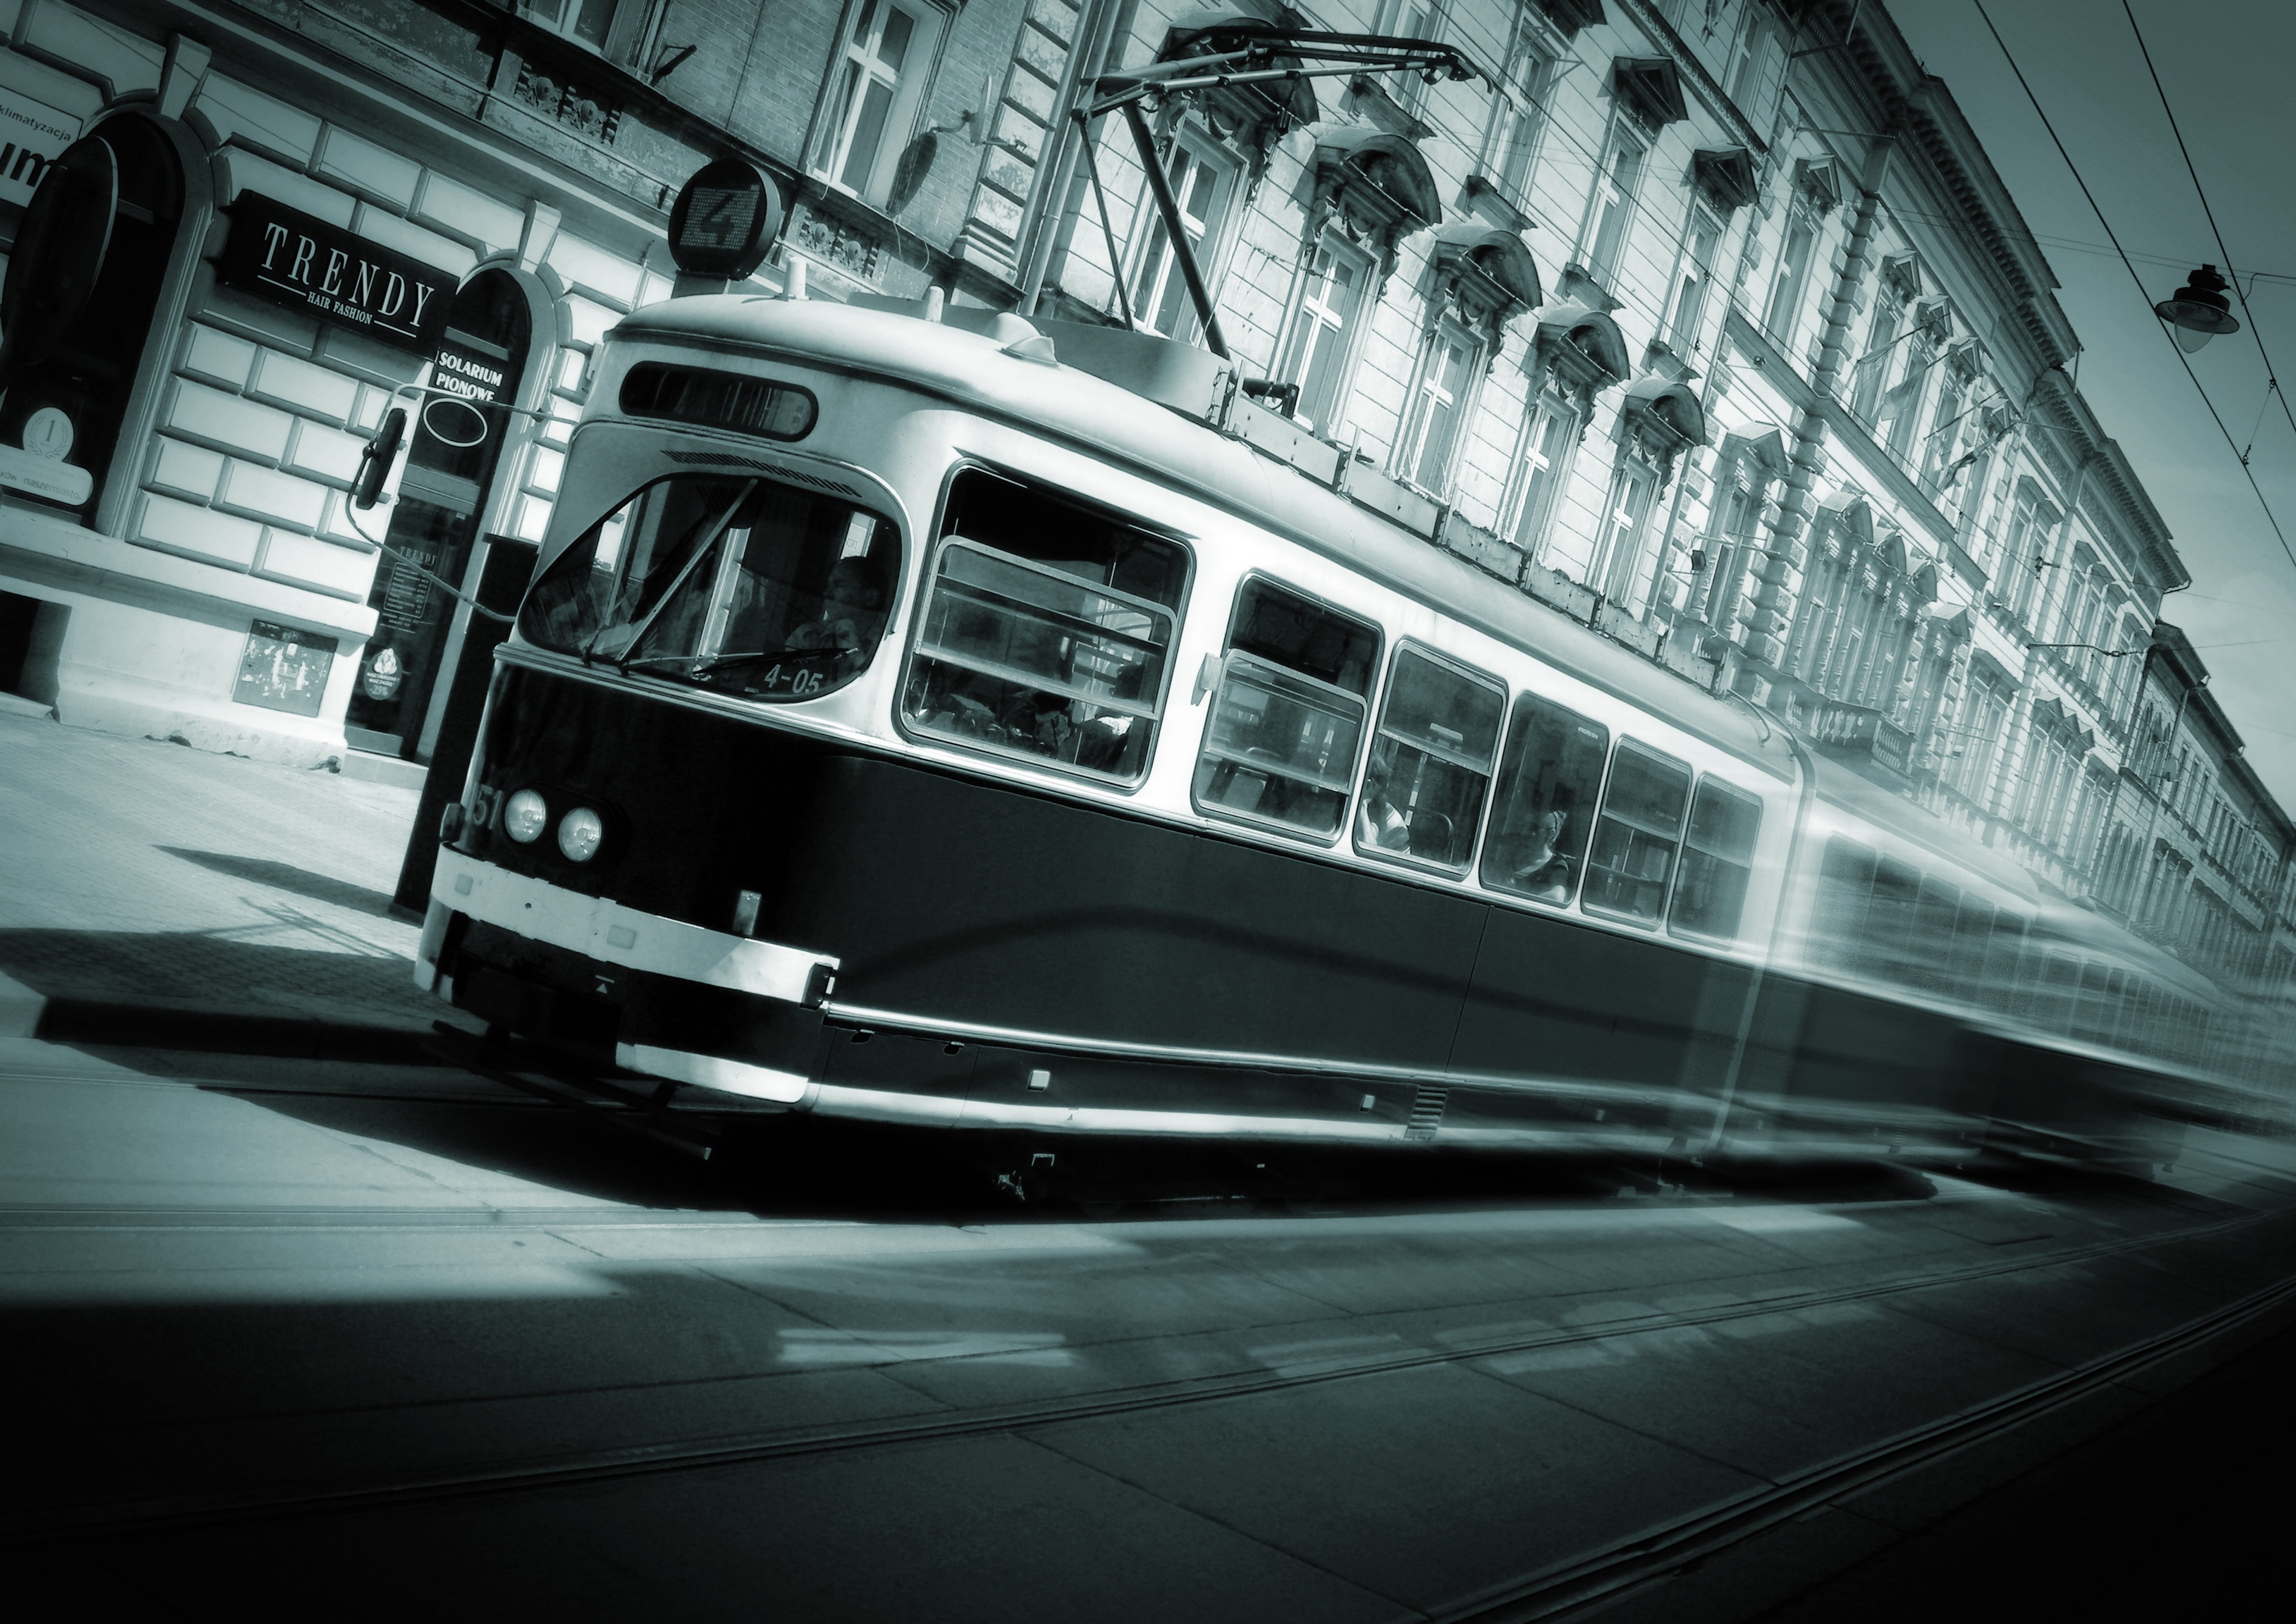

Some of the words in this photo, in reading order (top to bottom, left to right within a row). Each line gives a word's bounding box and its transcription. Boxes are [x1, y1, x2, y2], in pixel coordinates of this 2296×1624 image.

[0, 104, 71, 141] klimatyzacja
[700, 193, 736, 245] 4
[261, 222, 435, 327] TRENDY
[307, 291, 330, 310] HAIR
[333, 301, 373, 325] FASHION
[438, 352, 504, 387] SOLARIUM
[436, 372, 495, 402] PIONOWE
[46, 419, 56, 441] 1
[400, 545, 437, 565] TRENDY
[764, 664, 823, 693] 4-05
